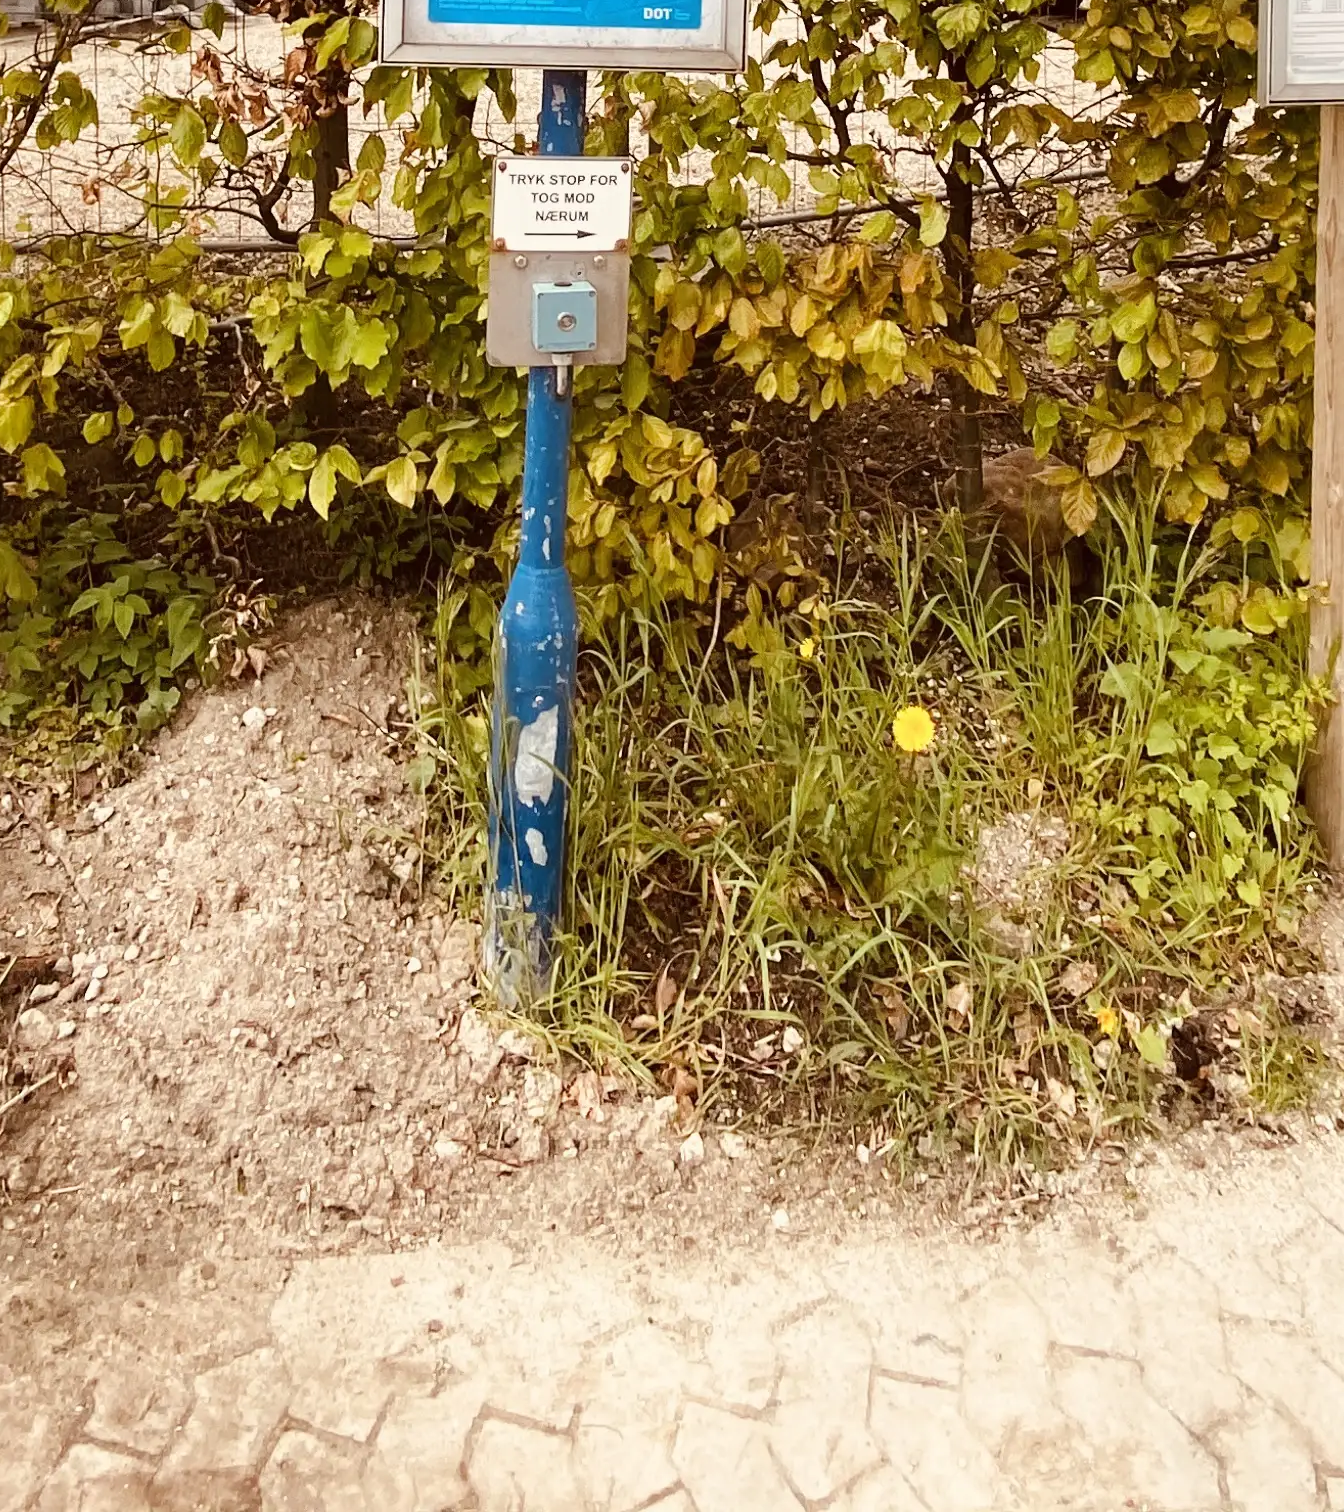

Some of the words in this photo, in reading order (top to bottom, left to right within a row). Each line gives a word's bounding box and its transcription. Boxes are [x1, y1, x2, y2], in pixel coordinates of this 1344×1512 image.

[643, 7, 673, 21] DOT
[509, 174, 545, 186] TRYK
[549, 174, 586, 186] STOP
[590, 175, 618, 186] FOR
[531, 192, 560, 204] TOG
[564, 192, 595, 204] MOD
[535, 210, 589, 222] NÆRUM
